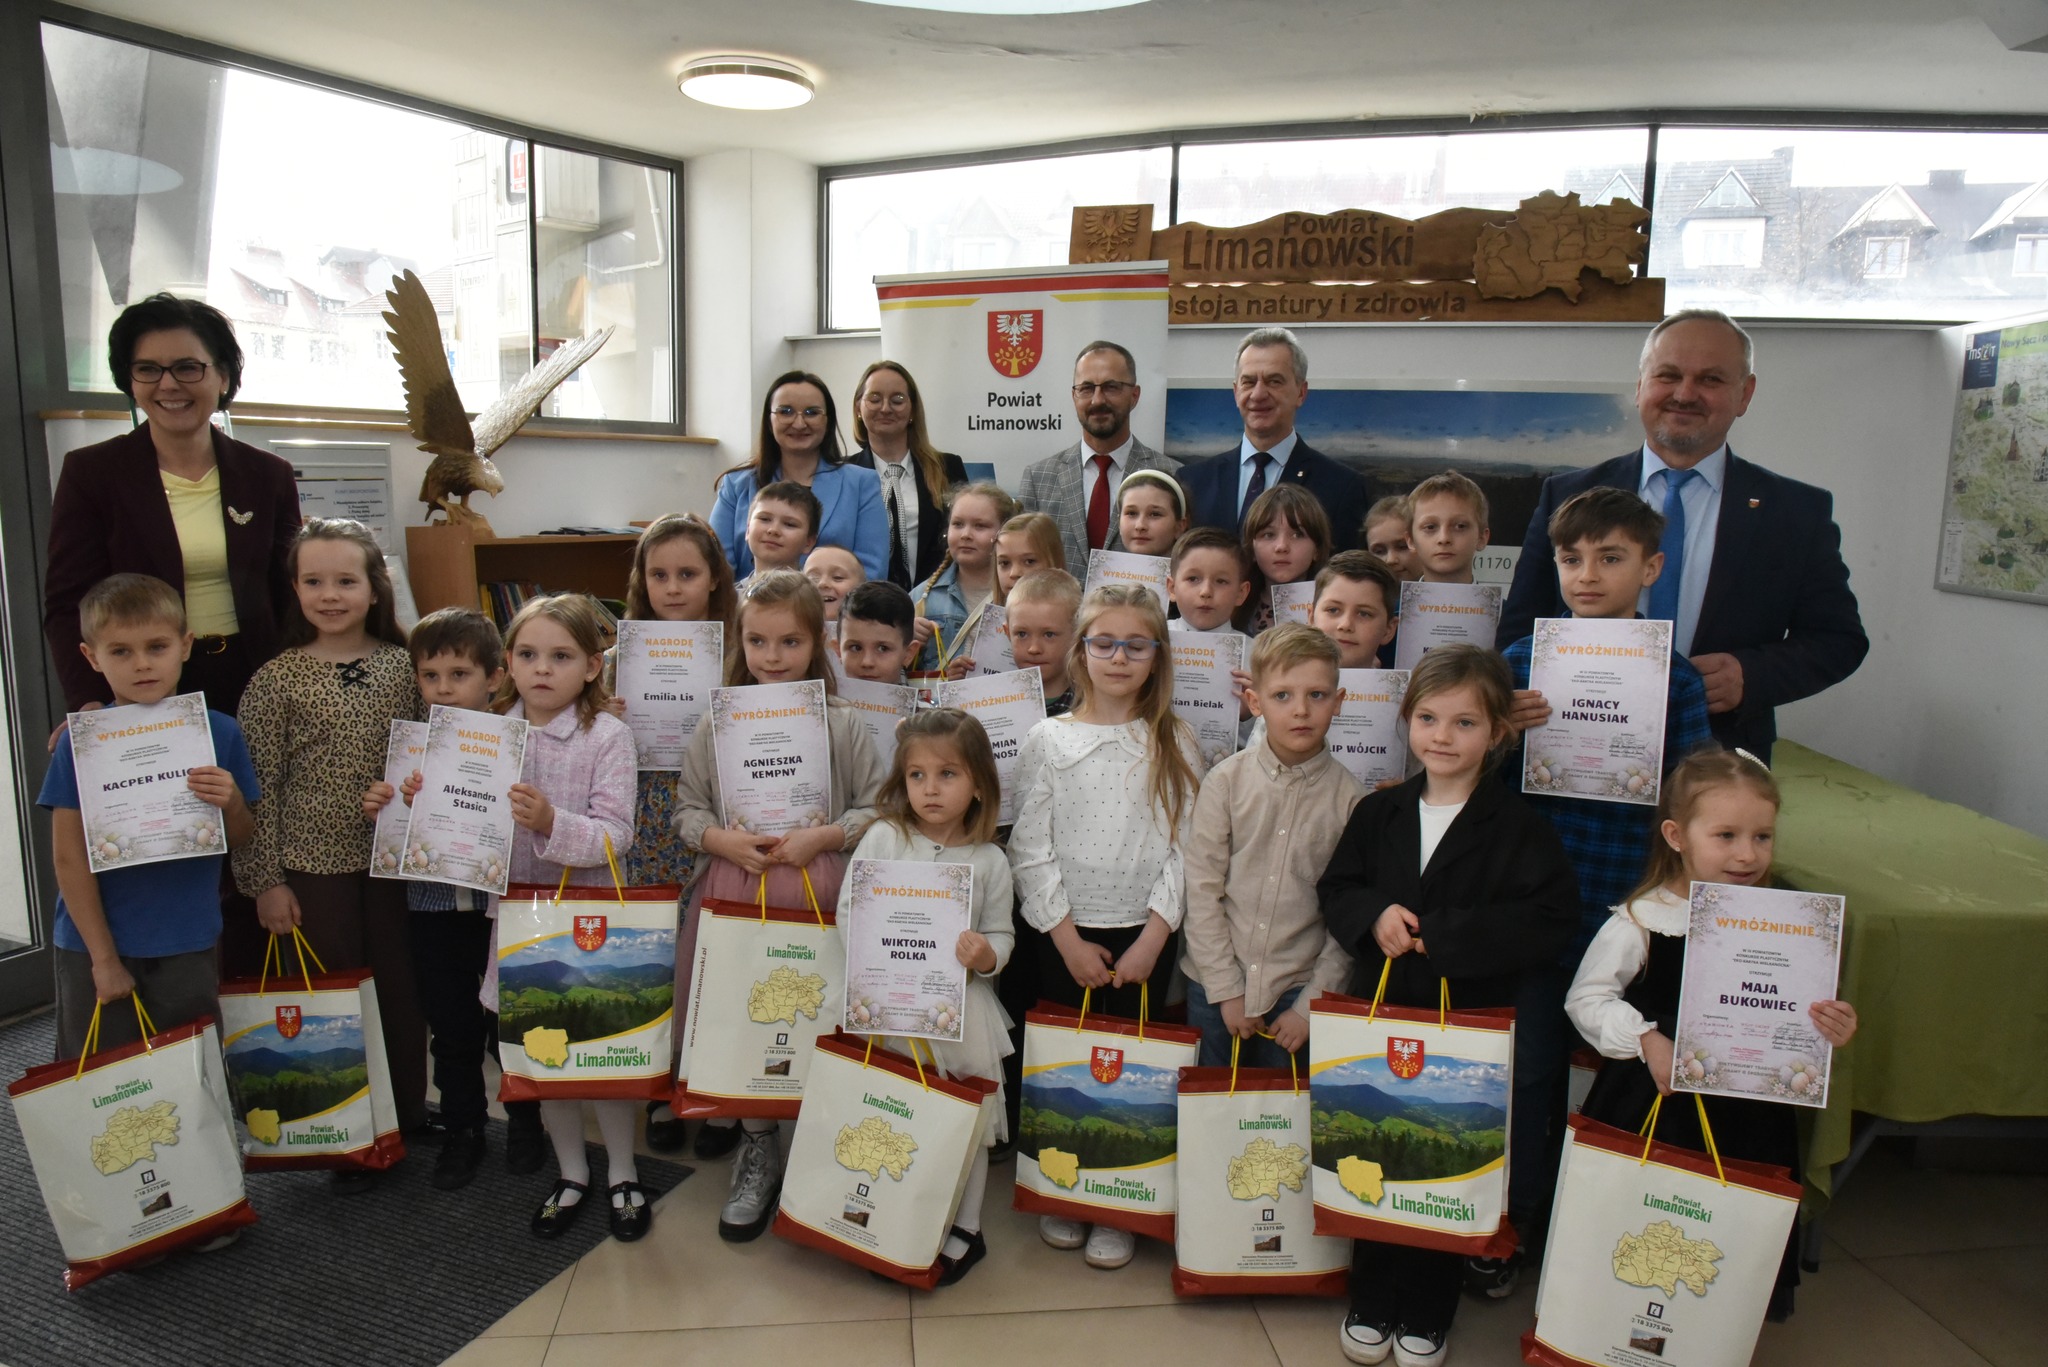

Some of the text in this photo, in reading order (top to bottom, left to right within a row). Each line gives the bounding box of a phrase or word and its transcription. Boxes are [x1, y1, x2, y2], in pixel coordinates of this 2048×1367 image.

[1284, 213, 1378, 236] Powiat
[1182, 225, 1414, 271] Limanowski
[1247, 295, 1333, 318] natury
[1340, 294, 1347, 314] i
[1355, 293, 1465, 314] zdrowia
[988, 391, 1042, 407] Powiat
[968, 414, 1062, 431] Limanowski
[1103, 568, 1158, 583] WYRÓŻNIENIE
[1418, 603, 1485, 615] WYRÓŻNIENIE
[645, 638, 694, 648] NAGRODĘ
[1556, 643, 1645, 657] WYRÓŻNIENIE
[648, 648, 693, 660] GŁÓWNĄ
[644, 692, 694, 702] Emilia Lis
[959, 693, 1025, 711] WYRÓŻNIENIE
[1572, 698, 1620, 710] IGNACY
[1193, 699, 1224, 710] Bielak
[731, 706, 807, 721] WYRÓŻNIENIE
[1562, 711, 1629, 724] HANUSIAK
[97, 718, 185, 742] WYRÓŻNIENIE
[457, 729, 501, 745] NAGRODĘ
[459, 742, 498, 760] GŁÓWNĄ
[1347, 742, 1387, 755] WÓJCIK
[744, 755, 803, 768] AGNIESZKA
[752, 768, 797, 780] KEMPNY
[103, 775, 153, 792] KACPER
[443, 784, 497, 803] Aleksandra
[453, 799, 488, 813] Stasica
[872, 885, 951, 899] WYRÓŻNIENIE
[1716, 916, 1816, 937] WYRÓŻNIENIE
[787, 943, 808, 952] Powiat
[882, 937, 937, 949] WIKTORIA
[767, 946, 816, 961] Limanowski
[890, 950, 926, 961] ROLKA
[1741, 981, 1778, 995] MAJA
[1720, 994, 1797, 1012] BUKOWIEC
[607, 1046, 638, 1055] Powiat
[576, 1052, 651, 1068] Limanowski
[115, 1078, 140, 1091] Powiat
[93, 1079, 153, 1109] Limanowski
[862, 1092, 914, 1120] Limanowski
[885, 1095, 907, 1108] Powiat
[310, 1125, 334, 1133] Powiat
[1239, 1118, 1292, 1131] Limanowski
[287, 1128, 349, 1145] Limanowski
[1085, 1178, 1156, 1202] Limanowski
[1114, 1177, 1144, 1189] Powiat
[1426, 1192, 1461, 1206] Powiat
[1672, 1194, 1701, 1209] Powiat
[1392, 1193, 1475, 1221] Limanowski
[1643, 1193, 1712, 1223] Limanowski
